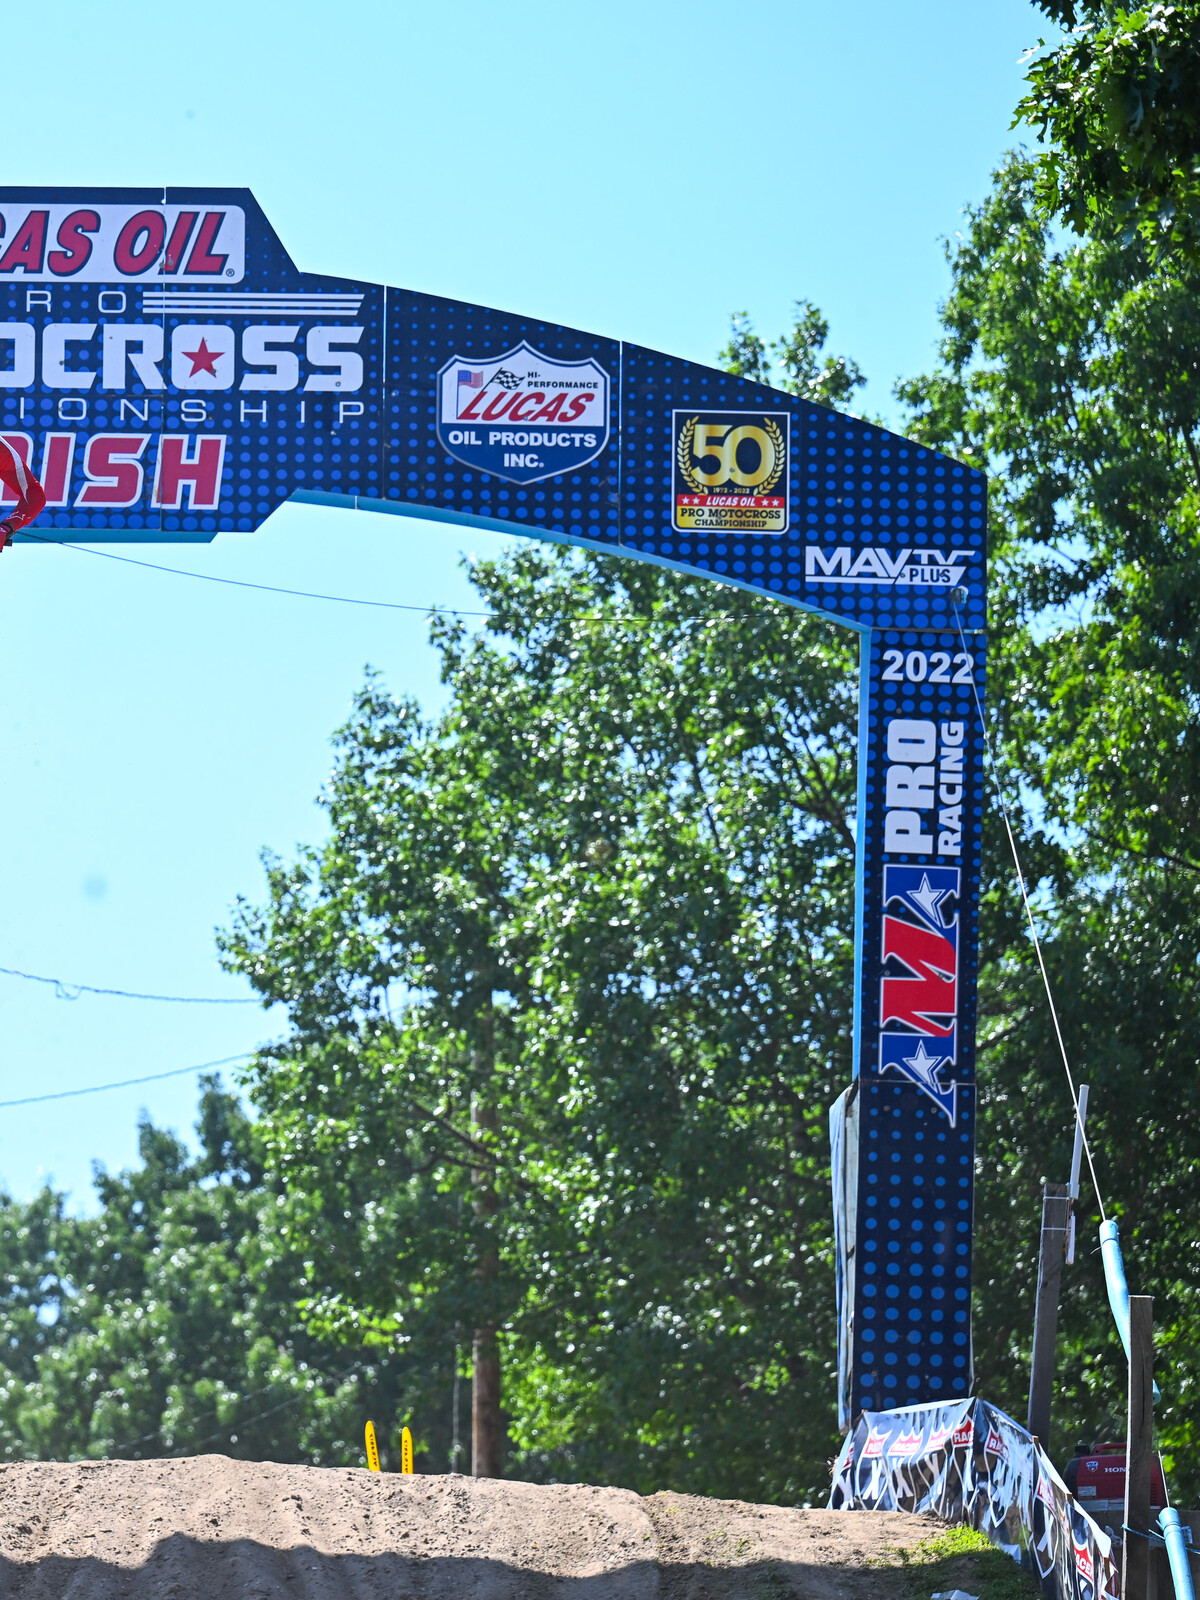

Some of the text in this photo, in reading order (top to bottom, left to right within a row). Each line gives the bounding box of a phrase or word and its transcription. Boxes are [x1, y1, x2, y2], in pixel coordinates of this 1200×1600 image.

[113, 210, 231, 277] OIL
[527, 371, 541, 379] HI-
[527, 381, 599, 389] PERFORMANCE
[457, 391, 595, 423] LUCAS
[448, 431, 597, 448] OIL PRODUCTS
[689, 424, 776, 488] 50
[706, 496, 756, 506] LUCAS OIL
[680, 508, 781, 519] PRO MOTOCROSS
[694, 518, 767, 528] CHAMPIONSHIP
[805, 546, 976, 578] MAVTV
[909, 568, 951, 583] PLUS
[881, 650, 974, 684] 2022
[884, 718, 937, 854] PRO
[938, 721, 964, 856] RACING
